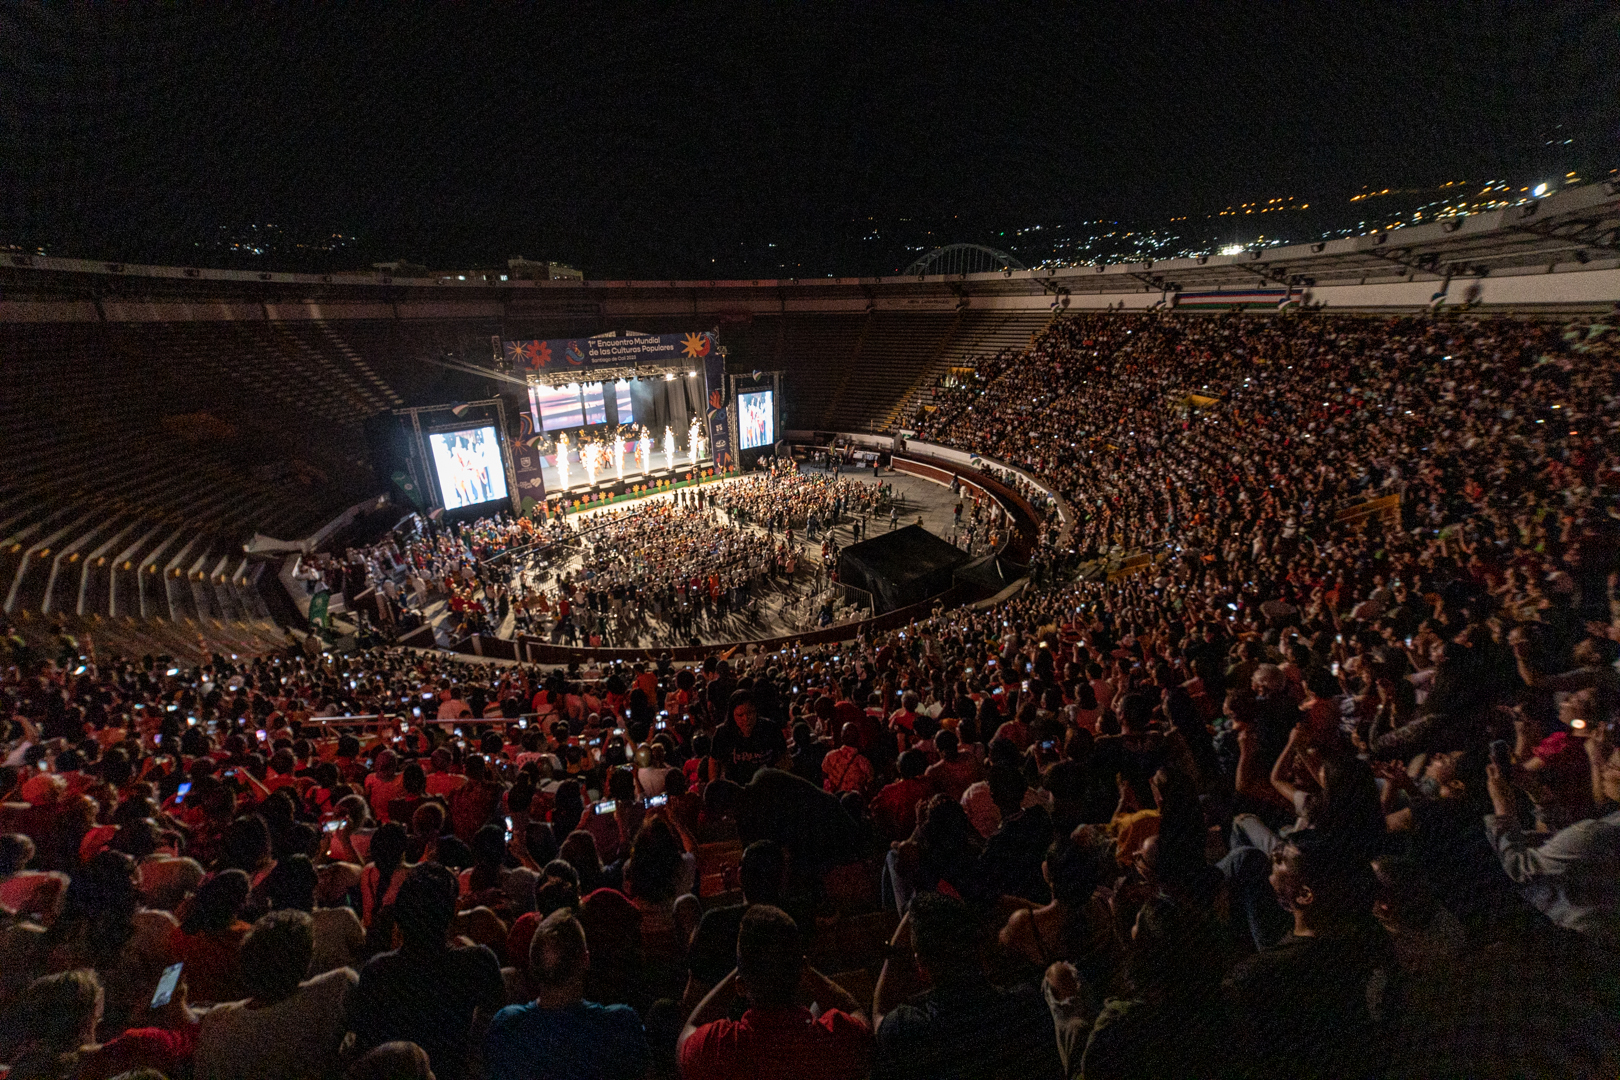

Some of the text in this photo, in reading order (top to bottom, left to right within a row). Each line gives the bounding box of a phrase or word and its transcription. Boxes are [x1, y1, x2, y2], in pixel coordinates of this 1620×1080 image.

[597, 339, 633, 347] Encuentro
[634, 336, 660, 345] Mundial
[611, 346, 641, 354] Culturas
[642, 344, 674, 353] Populares
